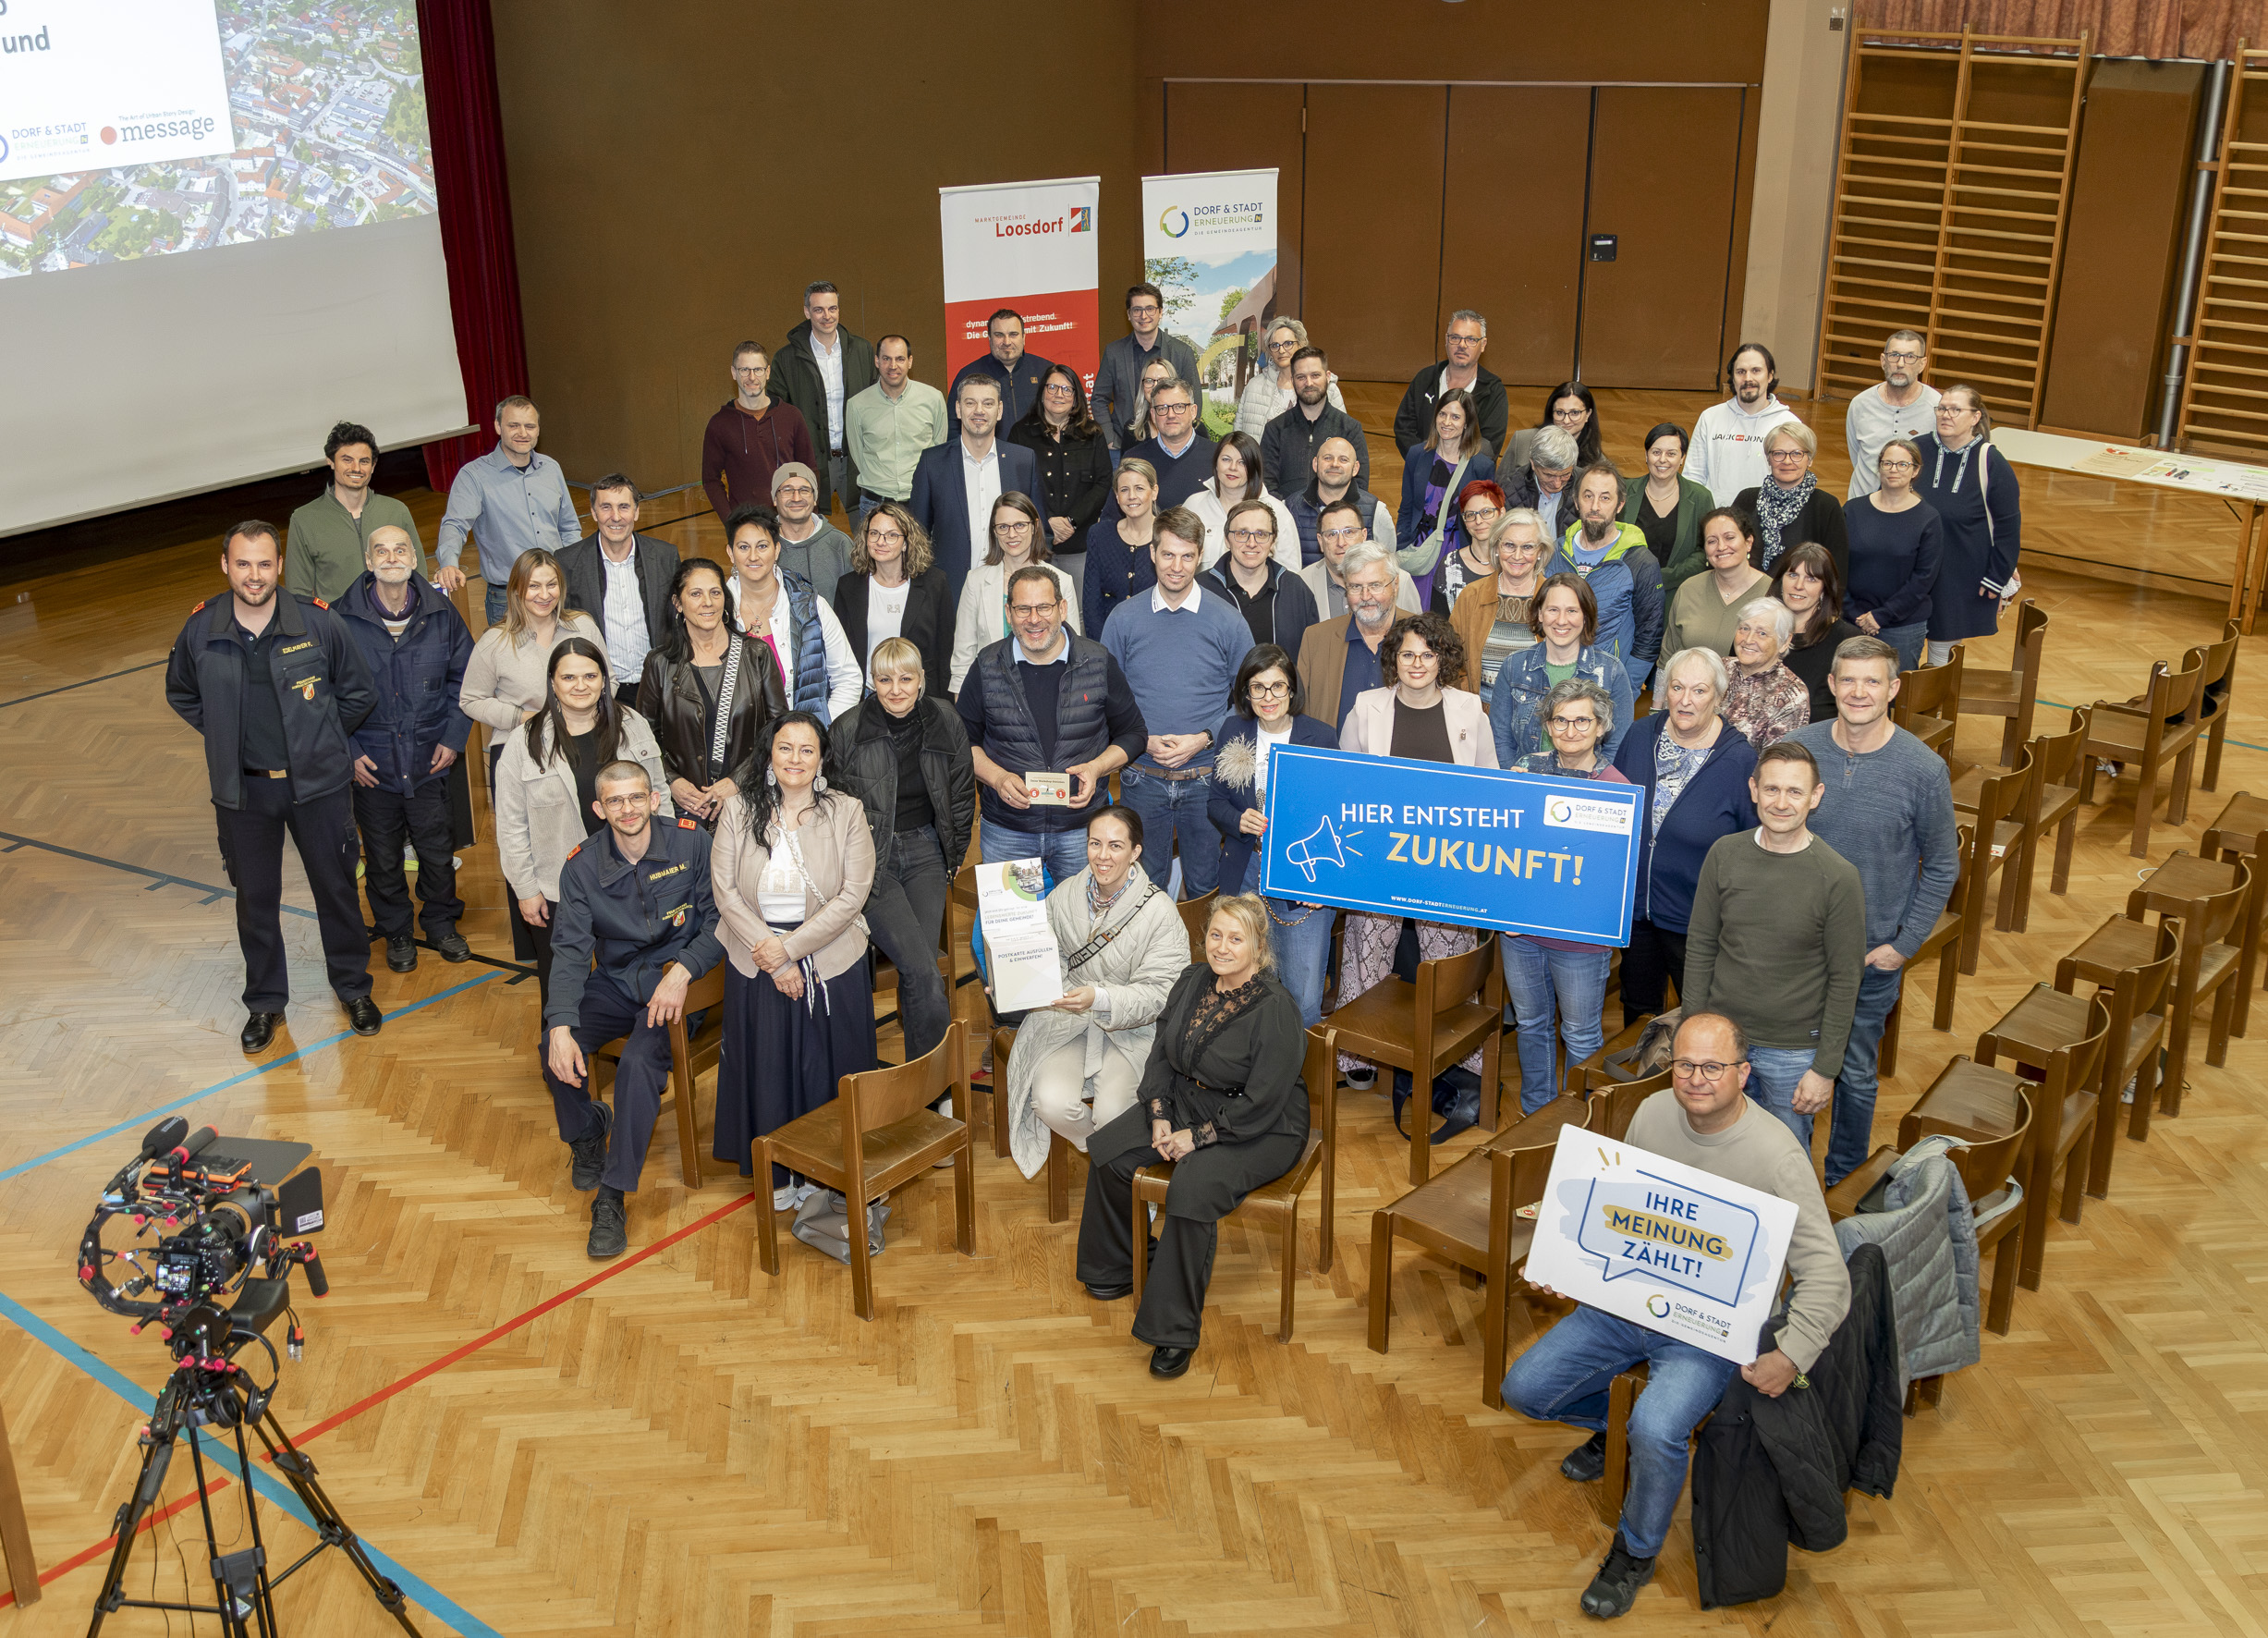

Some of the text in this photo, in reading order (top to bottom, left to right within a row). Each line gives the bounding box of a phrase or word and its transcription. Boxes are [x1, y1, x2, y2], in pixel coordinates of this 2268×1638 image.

[2, 25, 51, 54] und
[12, 122, 86, 139] DORF & STADT
[120, 116, 214, 141] message
[1194, 202, 1262, 215] DORF & STADT
[974, 214, 1026, 223] MARKTGEMEINDE
[995, 217, 1064, 238] Loosdorf
[1194, 214, 1253, 226] ERNEUERUNG
[1207, 226, 1262, 235] GEMEINDEAGENTUR
[1021, 312, 1056, 323] strebend.
[967, 331, 980, 340] Die
[1039, 322, 1073, 333] Zukunft!
[1744, 434, 1763, 443] JON
[1341, 802, 1525, 828] HIER ENTSTEHT
[1575, 804, 1597, 813] DORF
[1604, 808, 1627, 816] STADT
[1575, 813, 1619, 823] ERNEUERUNG
[1386, 831, 1584, 886] ZUKUNFT!
[1390, 895, 1488, 913] WWW.DORF-STADTERNEUERUNG.AT
[998, 947, 1054, 959] POSTKARTE AUSFÜLLEN
[1646, 1192, 1699, 1221] IHRE
[1612, 1210, 1723, 1255] MEINUNG
[1622, 1241, 1702, 1278] ZÄHLT!
[1673, 1311, 1721, 1334] ERNEUERUNG
[1675, 1302, 1698, 1315] DORF
[1706, 1314, 1731, 1329] STADT
